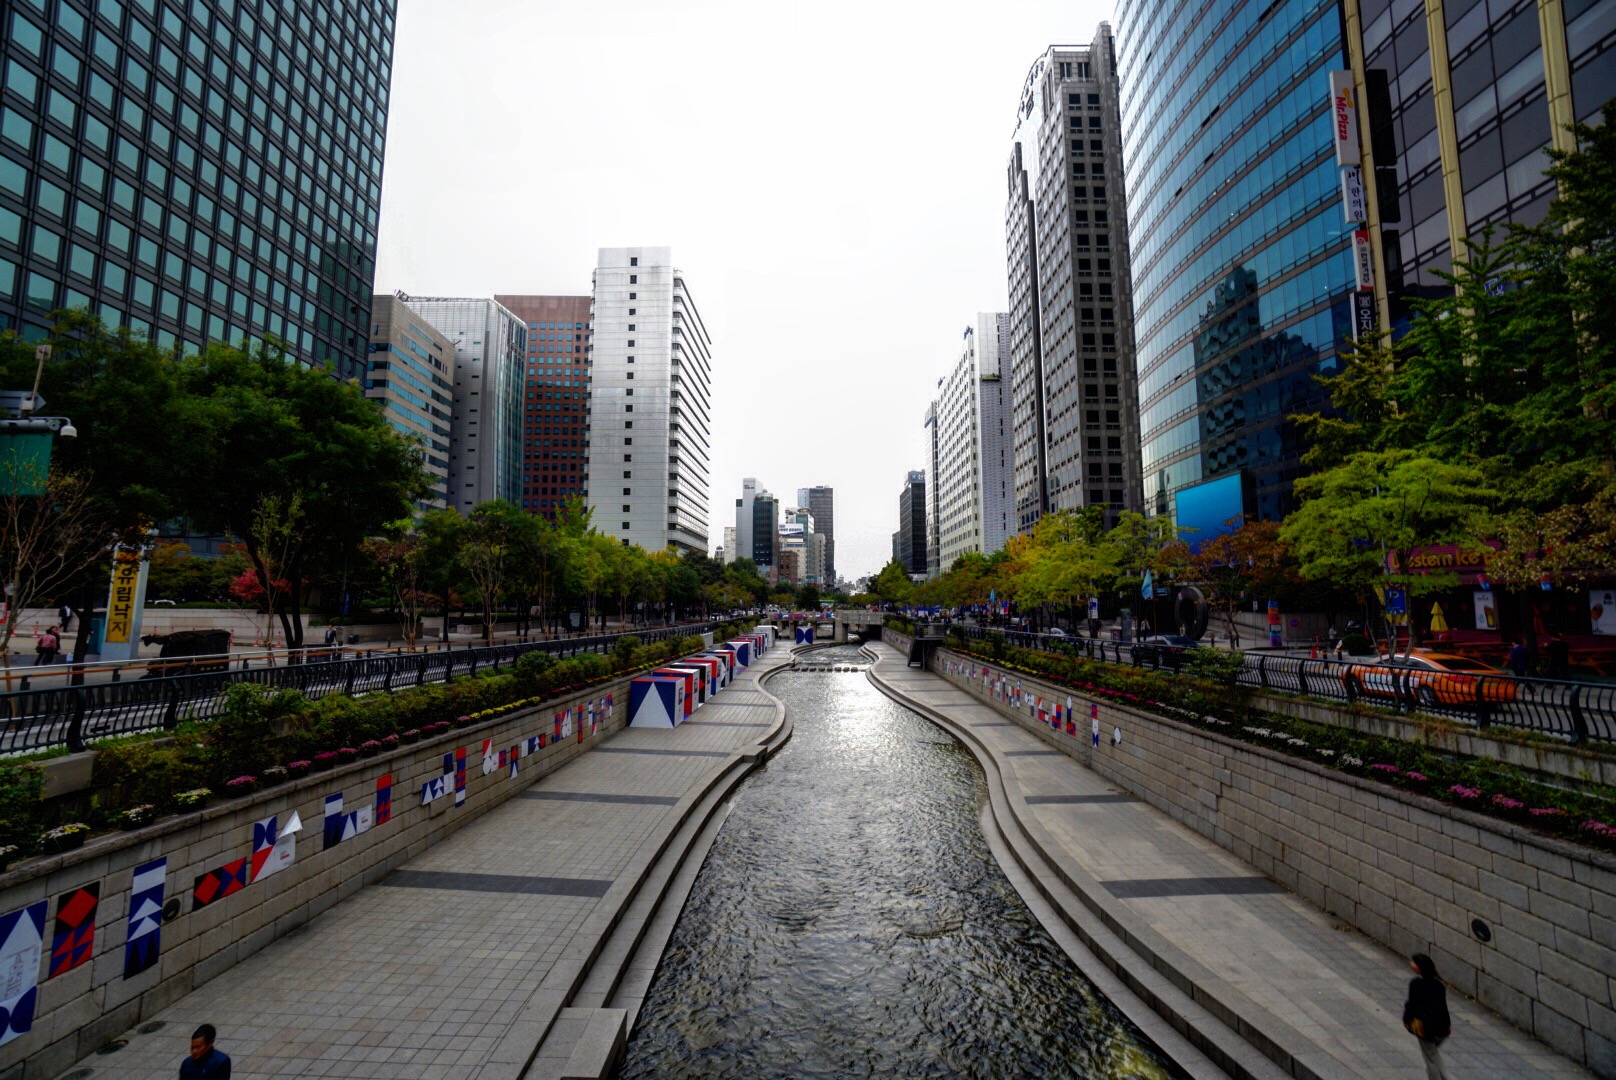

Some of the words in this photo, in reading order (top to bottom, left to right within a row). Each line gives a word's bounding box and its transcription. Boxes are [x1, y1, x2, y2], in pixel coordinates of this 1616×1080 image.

[1336, 96, 1349, 141] Mr.Pizza
[1455, 550, 1480, 566] Ice
[112, 568, 134, 637] 유림낙지
